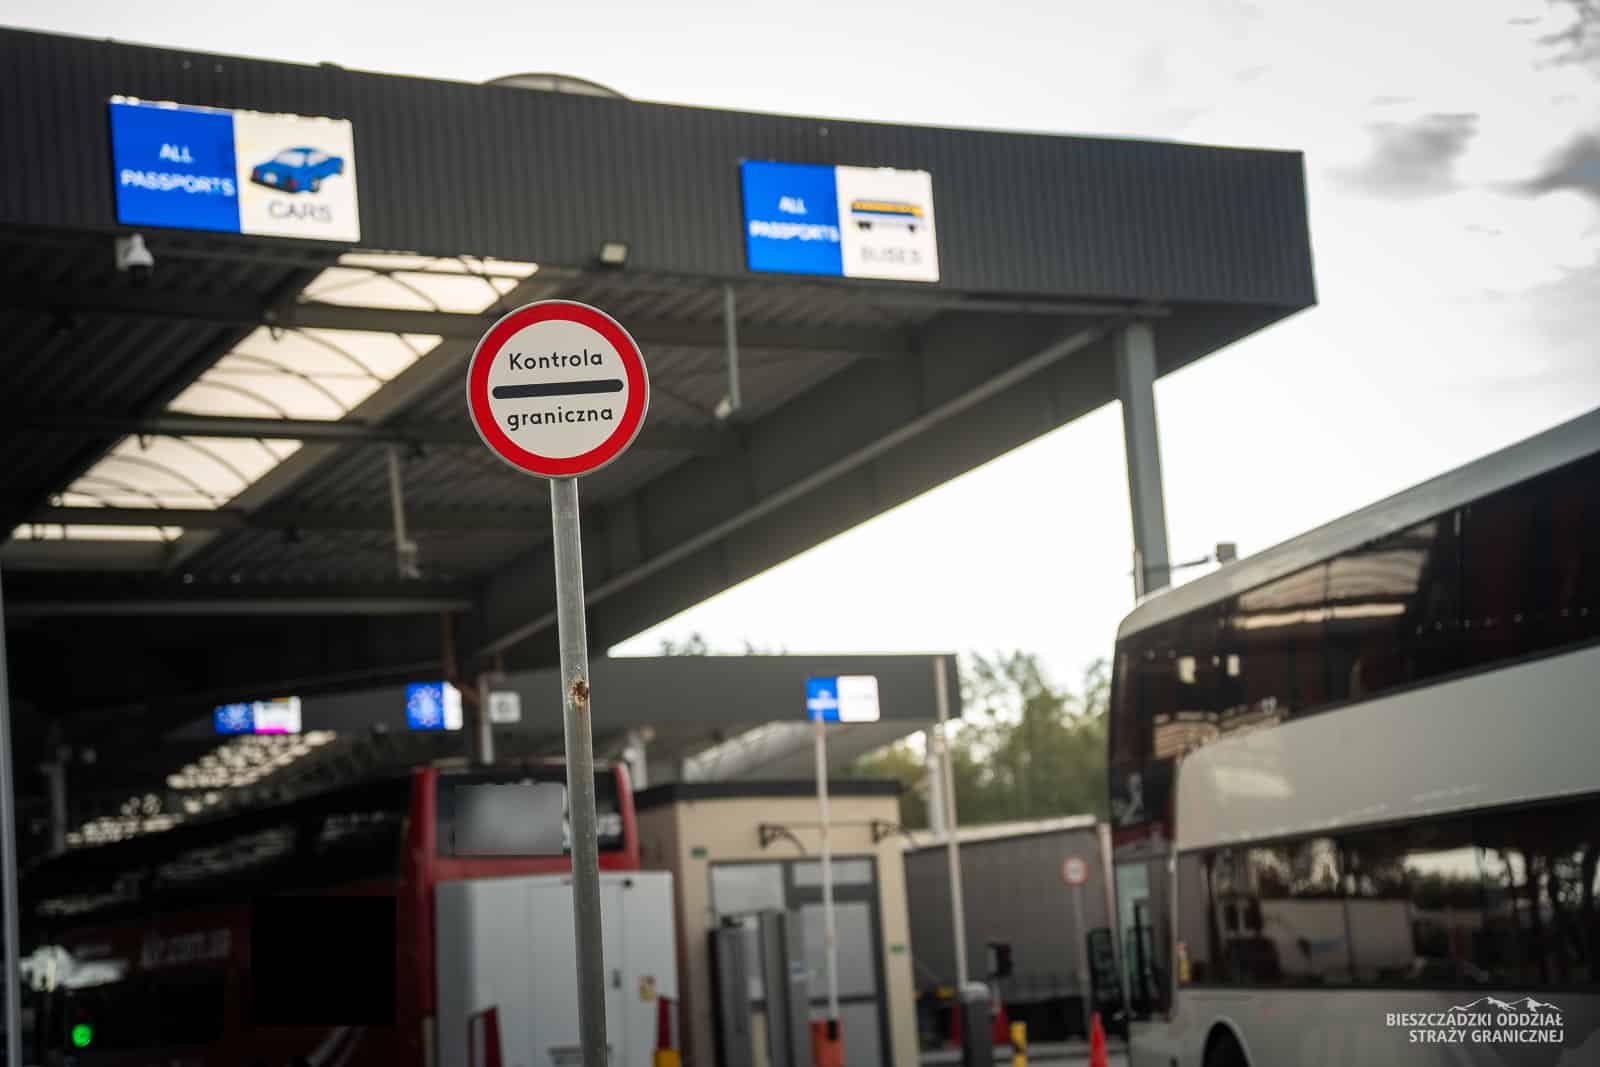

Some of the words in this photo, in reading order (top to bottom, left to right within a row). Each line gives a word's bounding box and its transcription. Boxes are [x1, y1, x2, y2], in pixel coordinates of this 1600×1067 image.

[160, 143, 195, 163] ALL
[120, 168, 235, 197] PASSPORTS
[268, 199, 333, 223] CARS
[778, 195, 808, 215] ALL
[749, 219, 841, 242] PASSPORTS
[509, 349, 603, 371] Kontrola
[507, 406, 613, 432] graniczna
